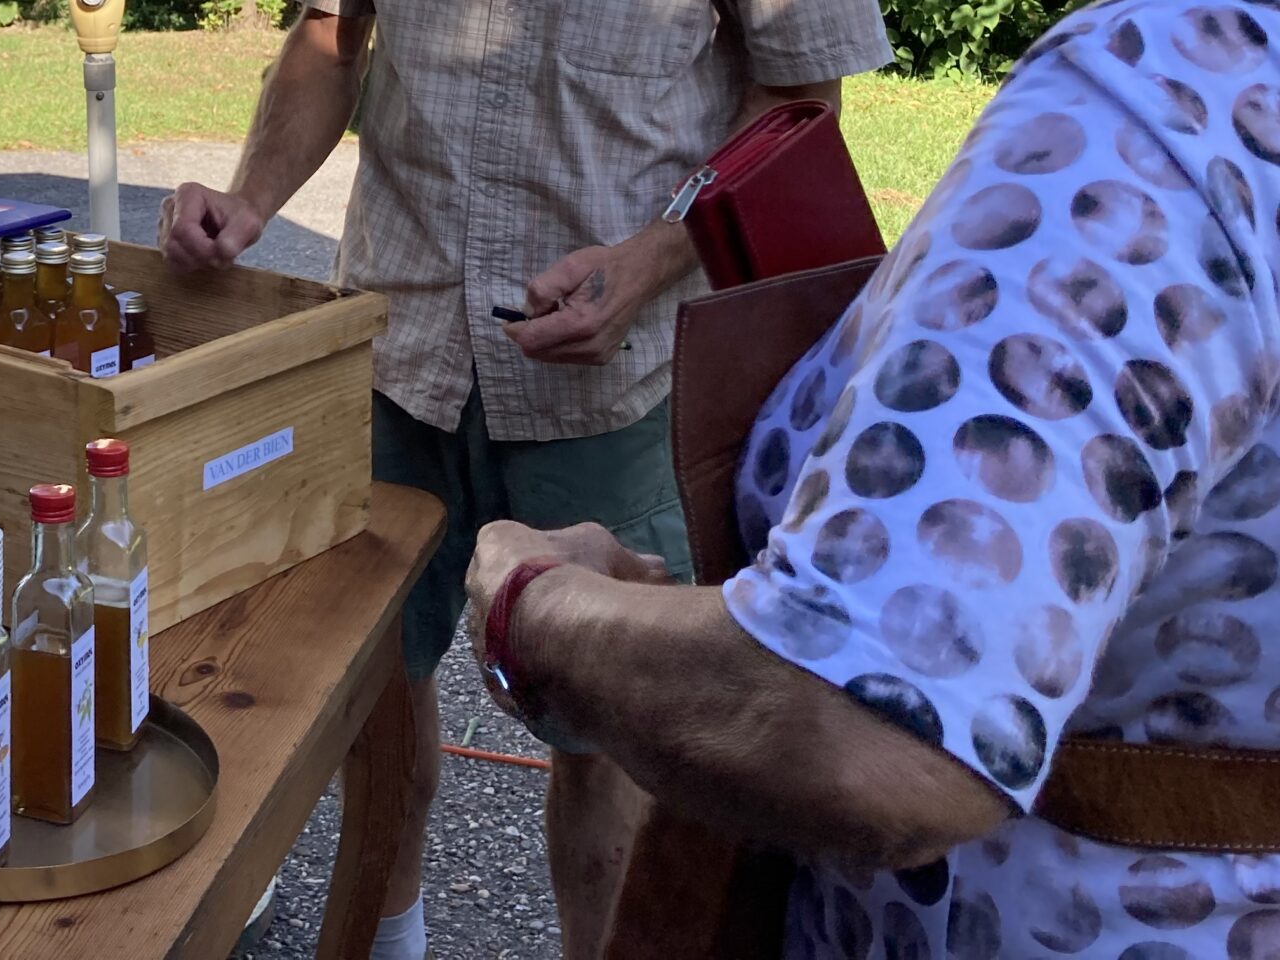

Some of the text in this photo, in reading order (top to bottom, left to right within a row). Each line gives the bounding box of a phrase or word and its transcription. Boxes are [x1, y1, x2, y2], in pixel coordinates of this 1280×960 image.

[209, 434, 290, 481] VAN DER BIEN
